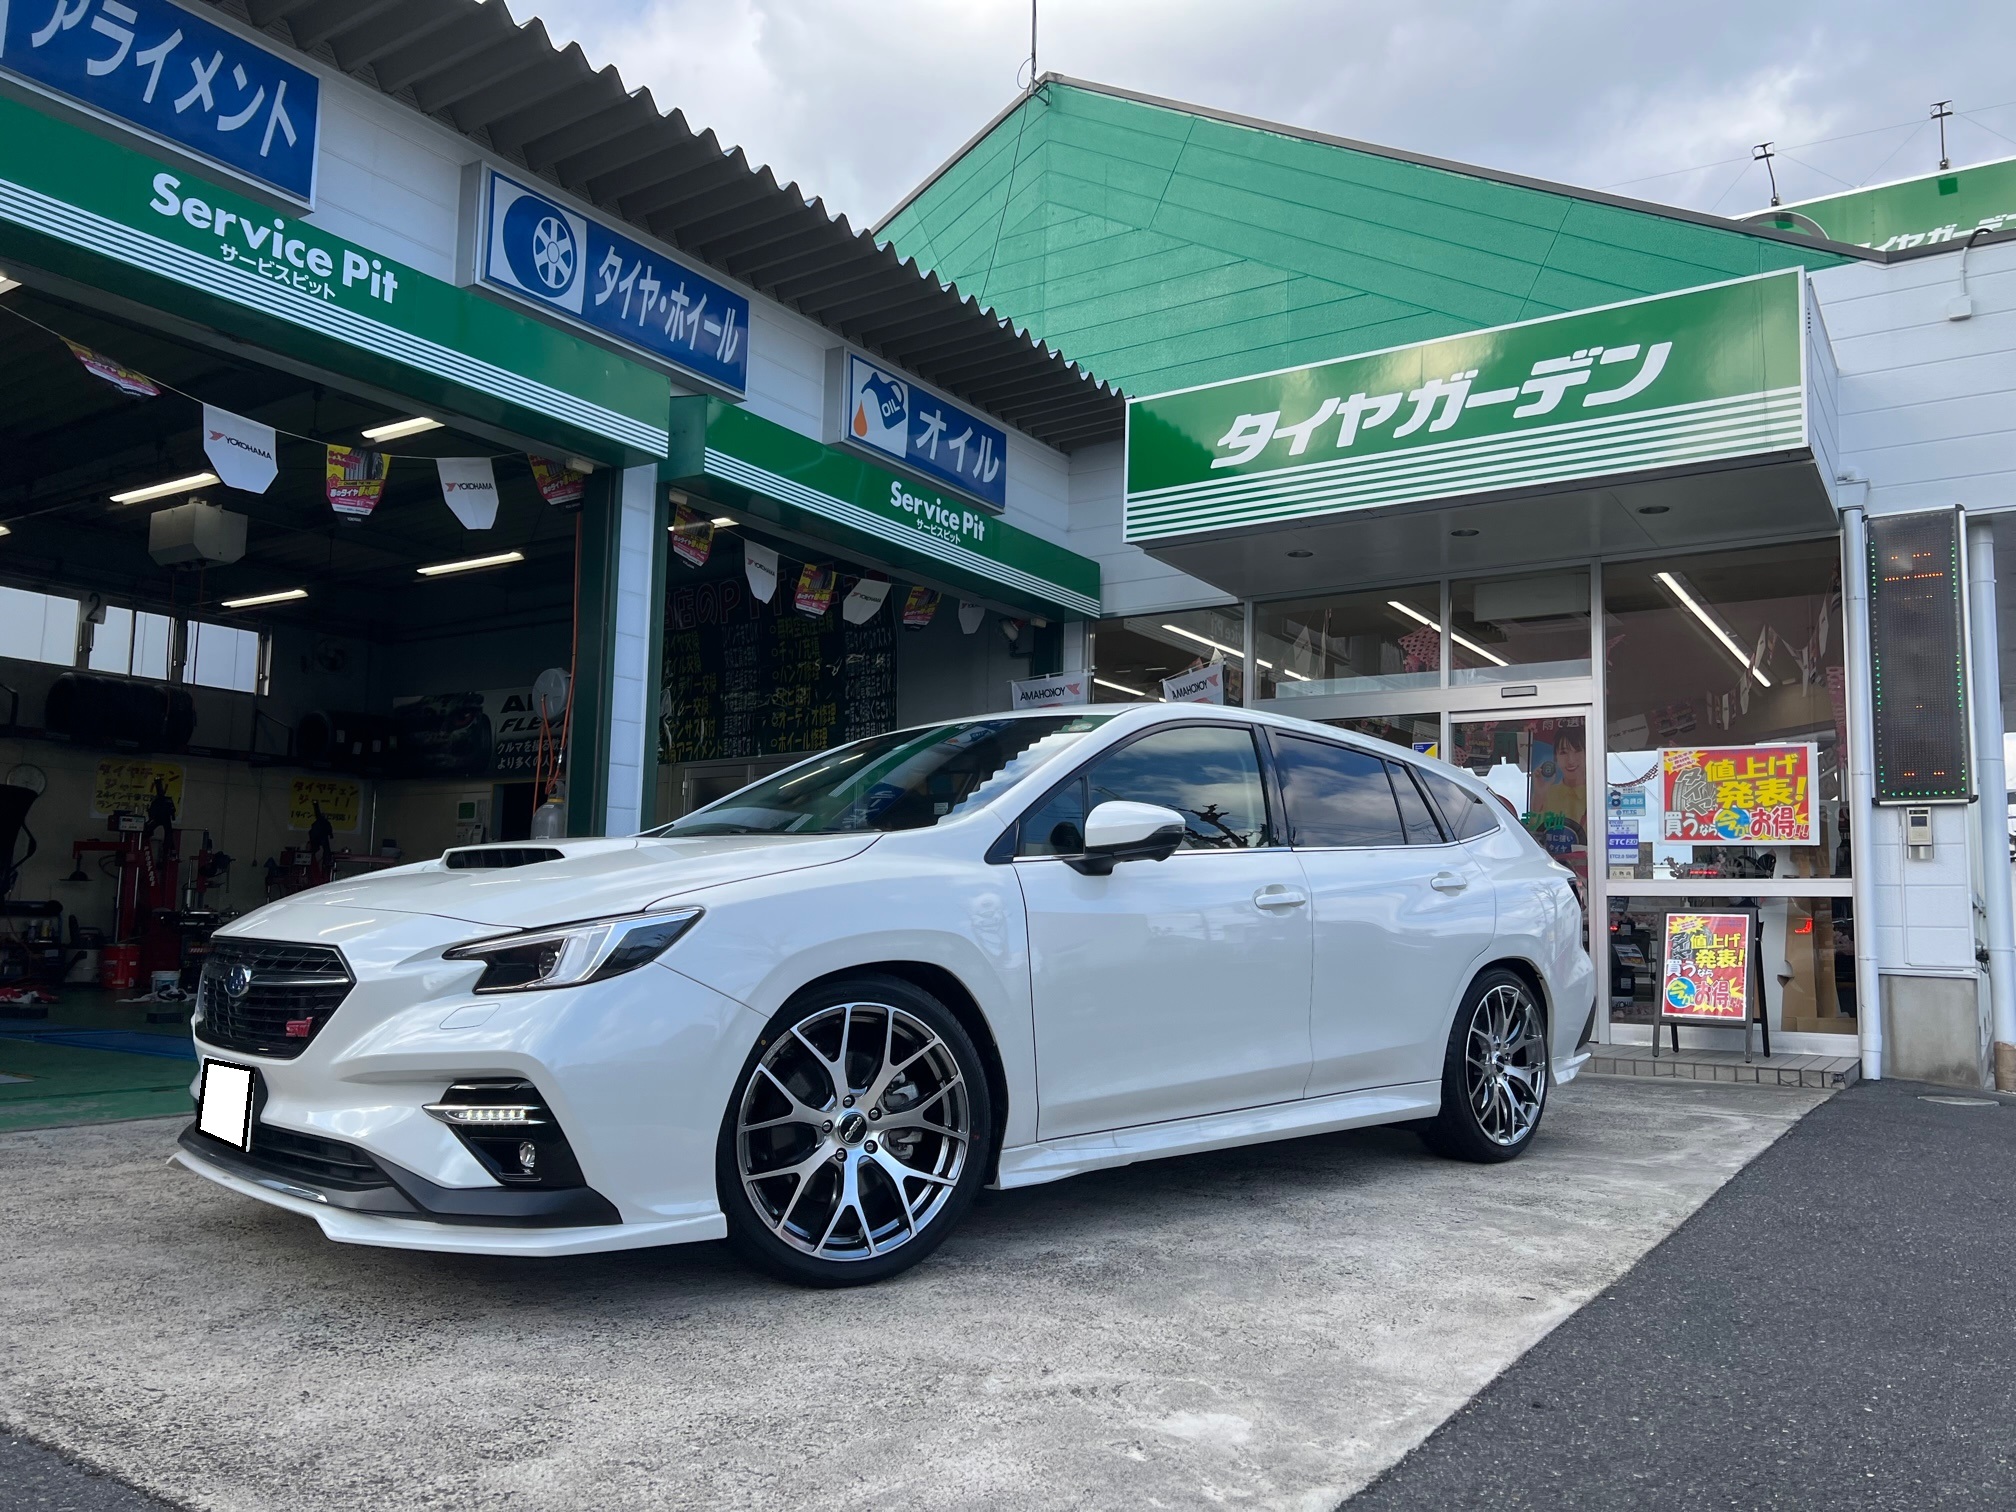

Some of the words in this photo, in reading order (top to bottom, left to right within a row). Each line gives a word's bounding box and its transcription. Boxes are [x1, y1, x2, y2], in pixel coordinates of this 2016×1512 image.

[31, 0, 297, 157] アライメント
[150, 172, 333, 277] Service
[342, 249, 398, 304] Pit
[220, 243, 336, 300] サービスピット
[595, 245, 739, 364] タイヤ・ホイール
[881, 398, 901, 418] OIL
[1210, 341, 1673, 470] タイヤガーデン
[224, 434, 273, 461] YOKOHAMA
[915, 409, 1000, 483] オイル
[456, 482, 493, 491] YOKOHAMA
[890, 480, 960, 531] Service
[962, 511, 985, 542] Pit
[86, 592, 100, 623] 2
[1704, 753, 1799, 783] 値上げ
[1716, 777, 1807, 810] 発表!
[1690, 933, 1741, 949] 値上げ
[1666, 959, 1714, 977] 買うなら
[1695, 948, 1745, 969] 発表!
